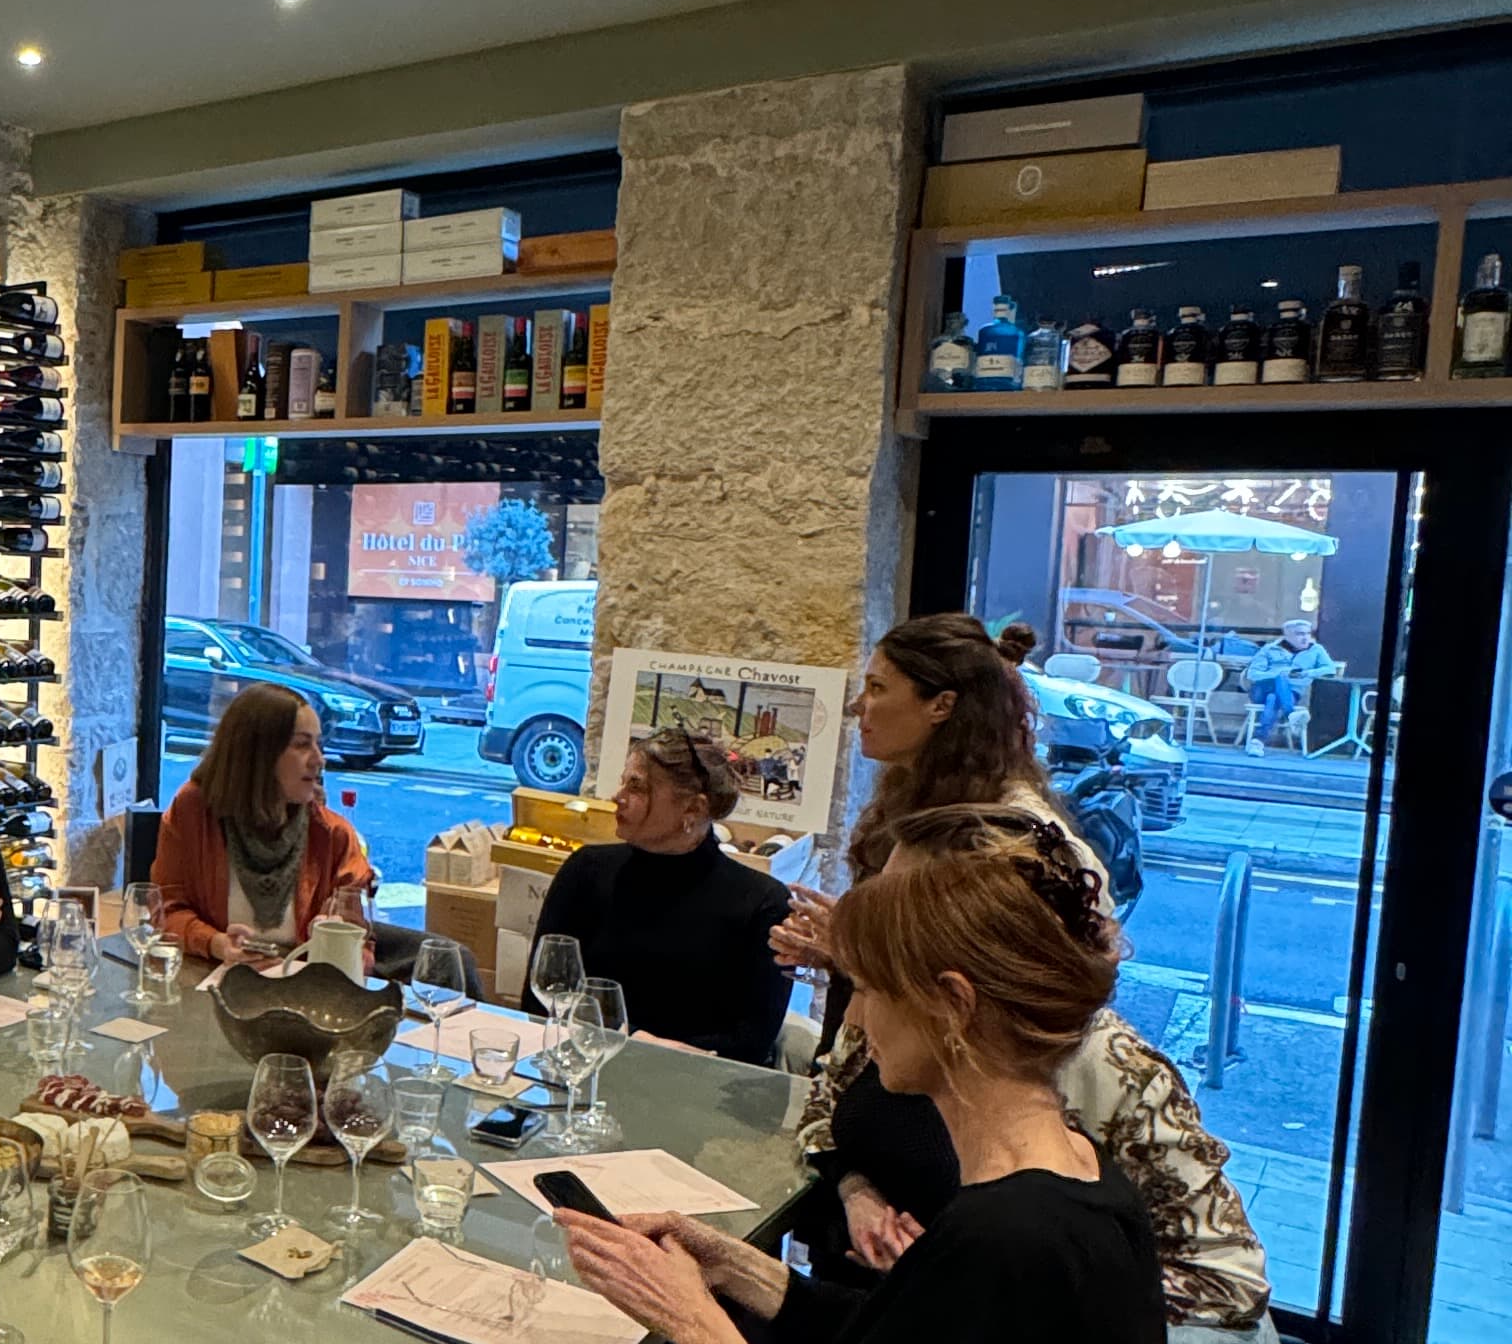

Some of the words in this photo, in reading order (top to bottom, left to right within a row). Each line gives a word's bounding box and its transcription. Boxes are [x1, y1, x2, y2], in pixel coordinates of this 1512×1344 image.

[362, 532, 414, 552] Hôtel
[421, 533, 445, 552] du
[408, 555, 437, 567] NICE
[649, 660, 732, 676] CHAMPAGNE
[738, 666, 801, 685] Chavost
